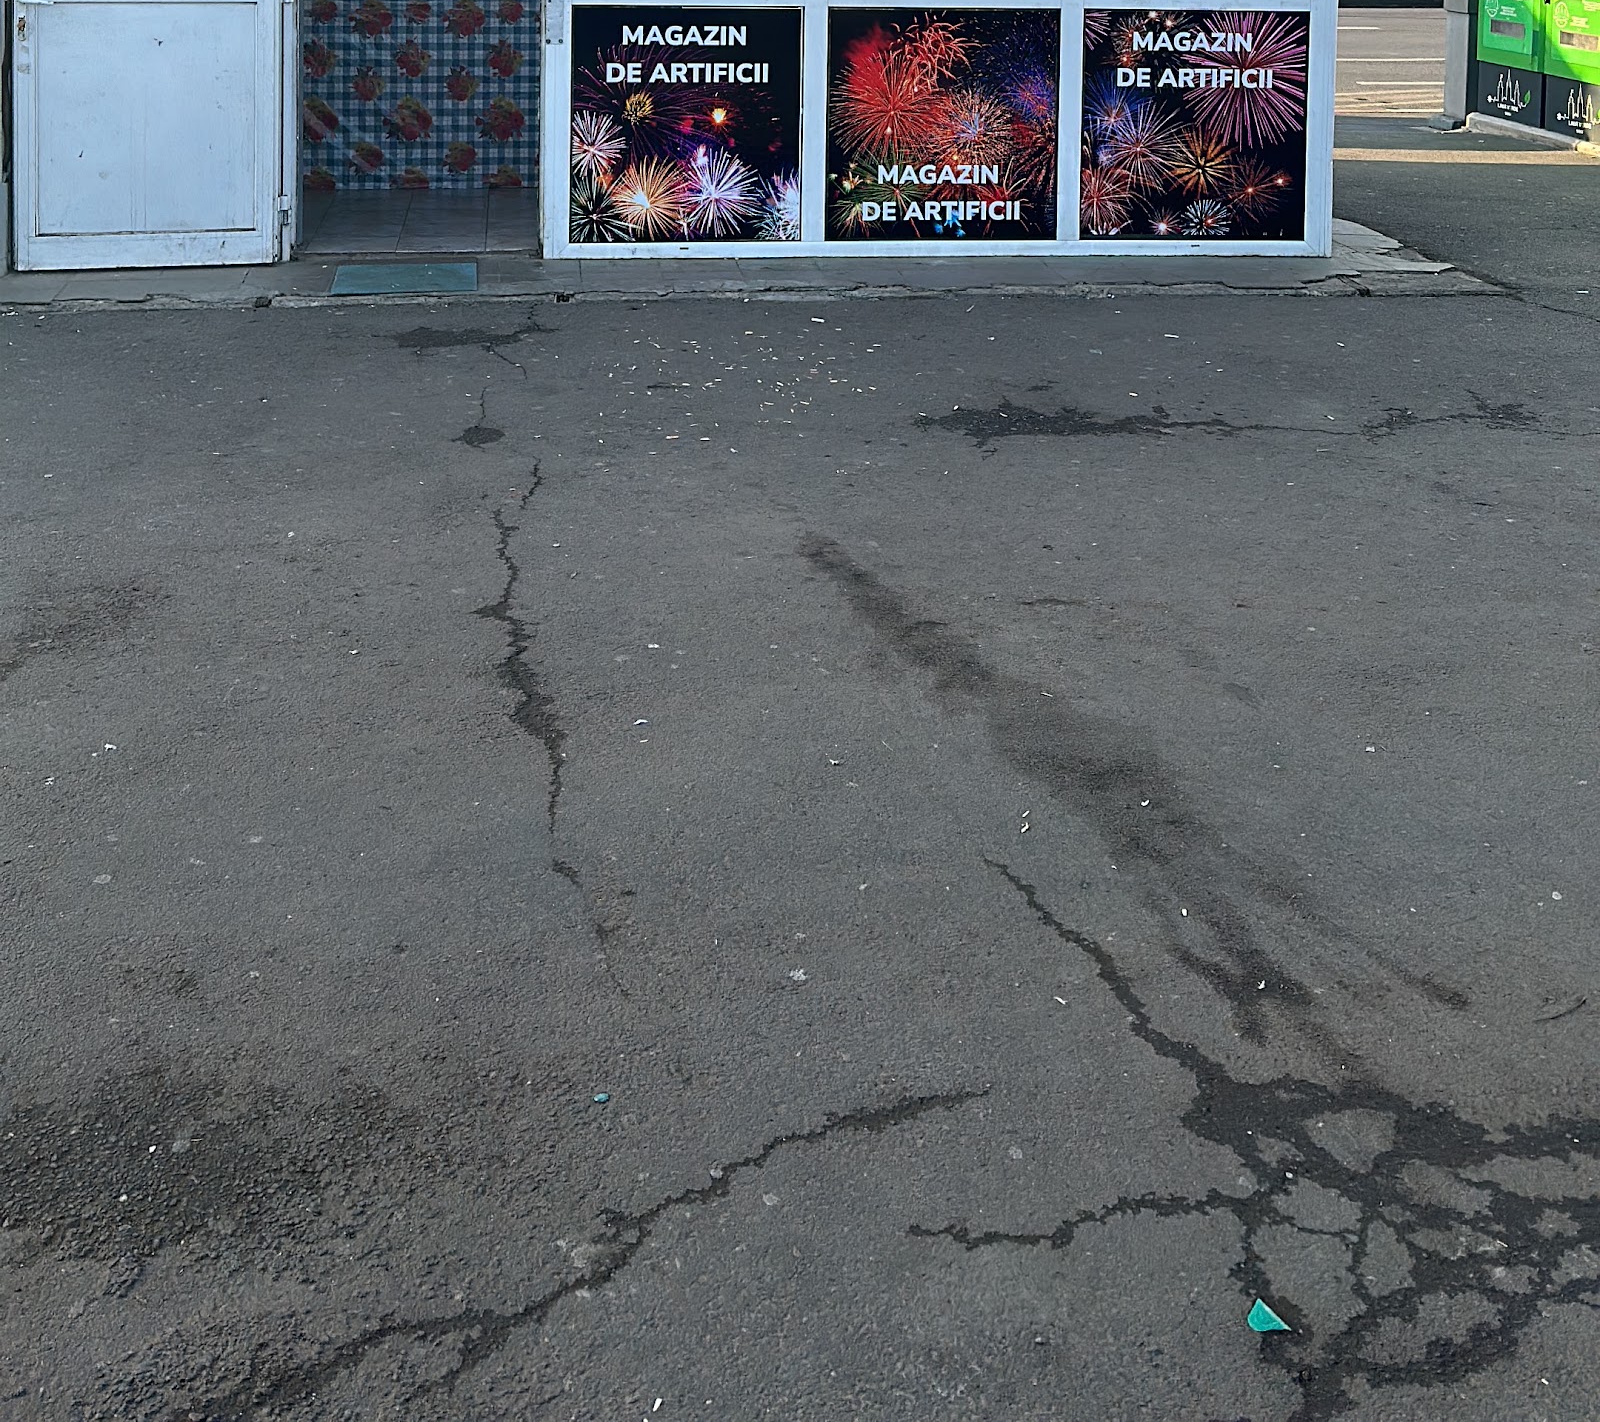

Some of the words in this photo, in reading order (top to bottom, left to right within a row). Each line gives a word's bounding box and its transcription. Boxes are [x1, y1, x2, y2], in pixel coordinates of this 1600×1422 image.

[622, 25, 747, 46] MAGAZIN
[1132, 32, 1253, 53] MAGAZIN
[606, 63, 646, 83] DE
[650, 62, 769, 84] ARTIFICII
[1117, 67, 1151, 88] DE
[1157, 67, 1273, 90] ARTIFICII
[877, 164, 999, 185] MAGAZIN
[862, 200, 897, 222] DE
[903, 200, 1021, 222] ARTIFICII
